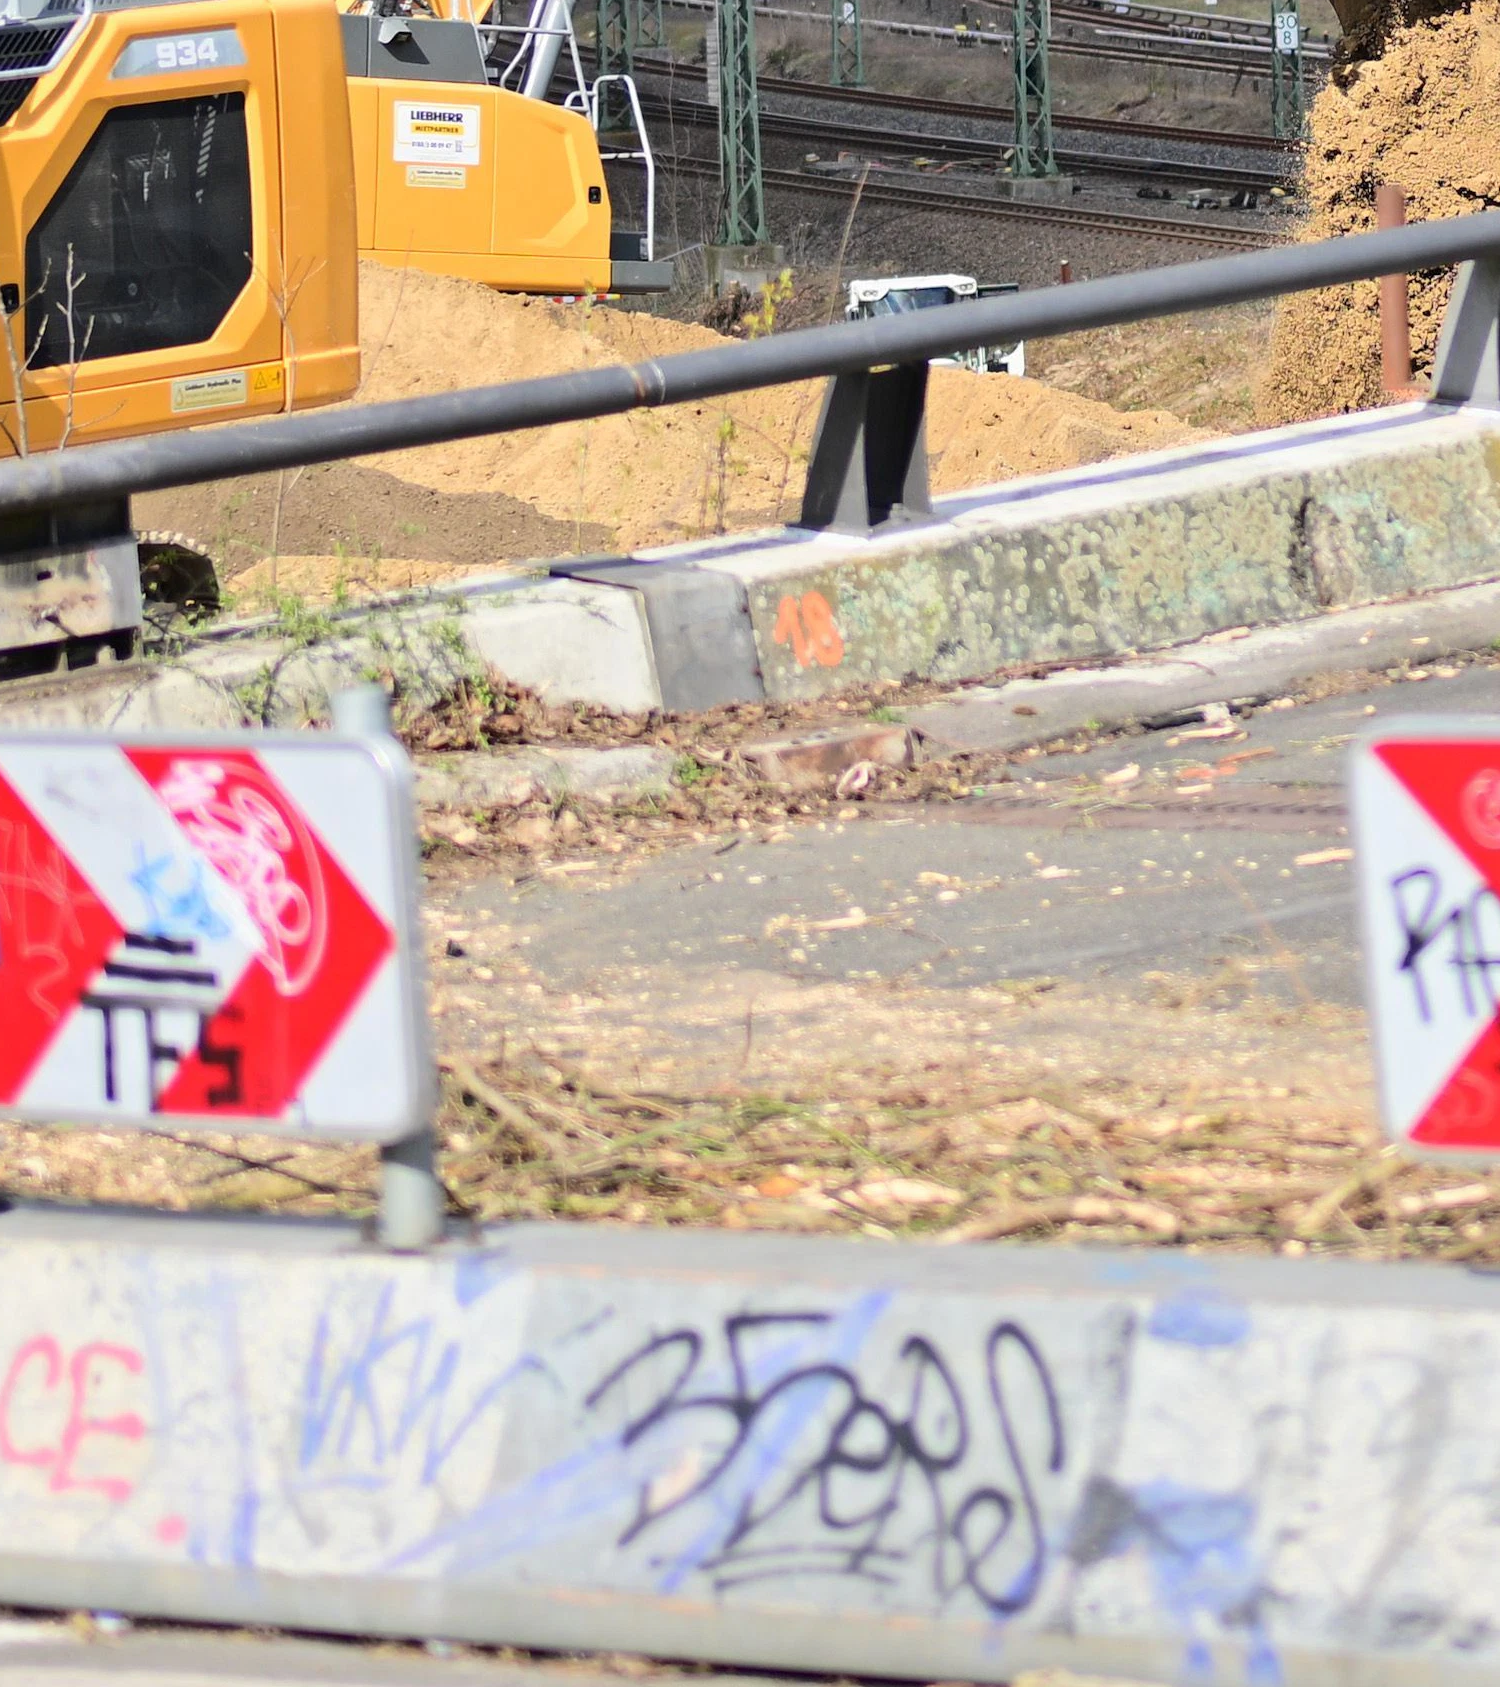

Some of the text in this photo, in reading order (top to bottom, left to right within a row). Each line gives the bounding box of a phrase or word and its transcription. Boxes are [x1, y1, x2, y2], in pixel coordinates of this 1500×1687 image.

[1276, 15, 1297, 30] 30
[1283, 31, 1292, 45] 8
[156, 37, 219, 68] 934
[410, 110, 464, 123] LIEBHERR
